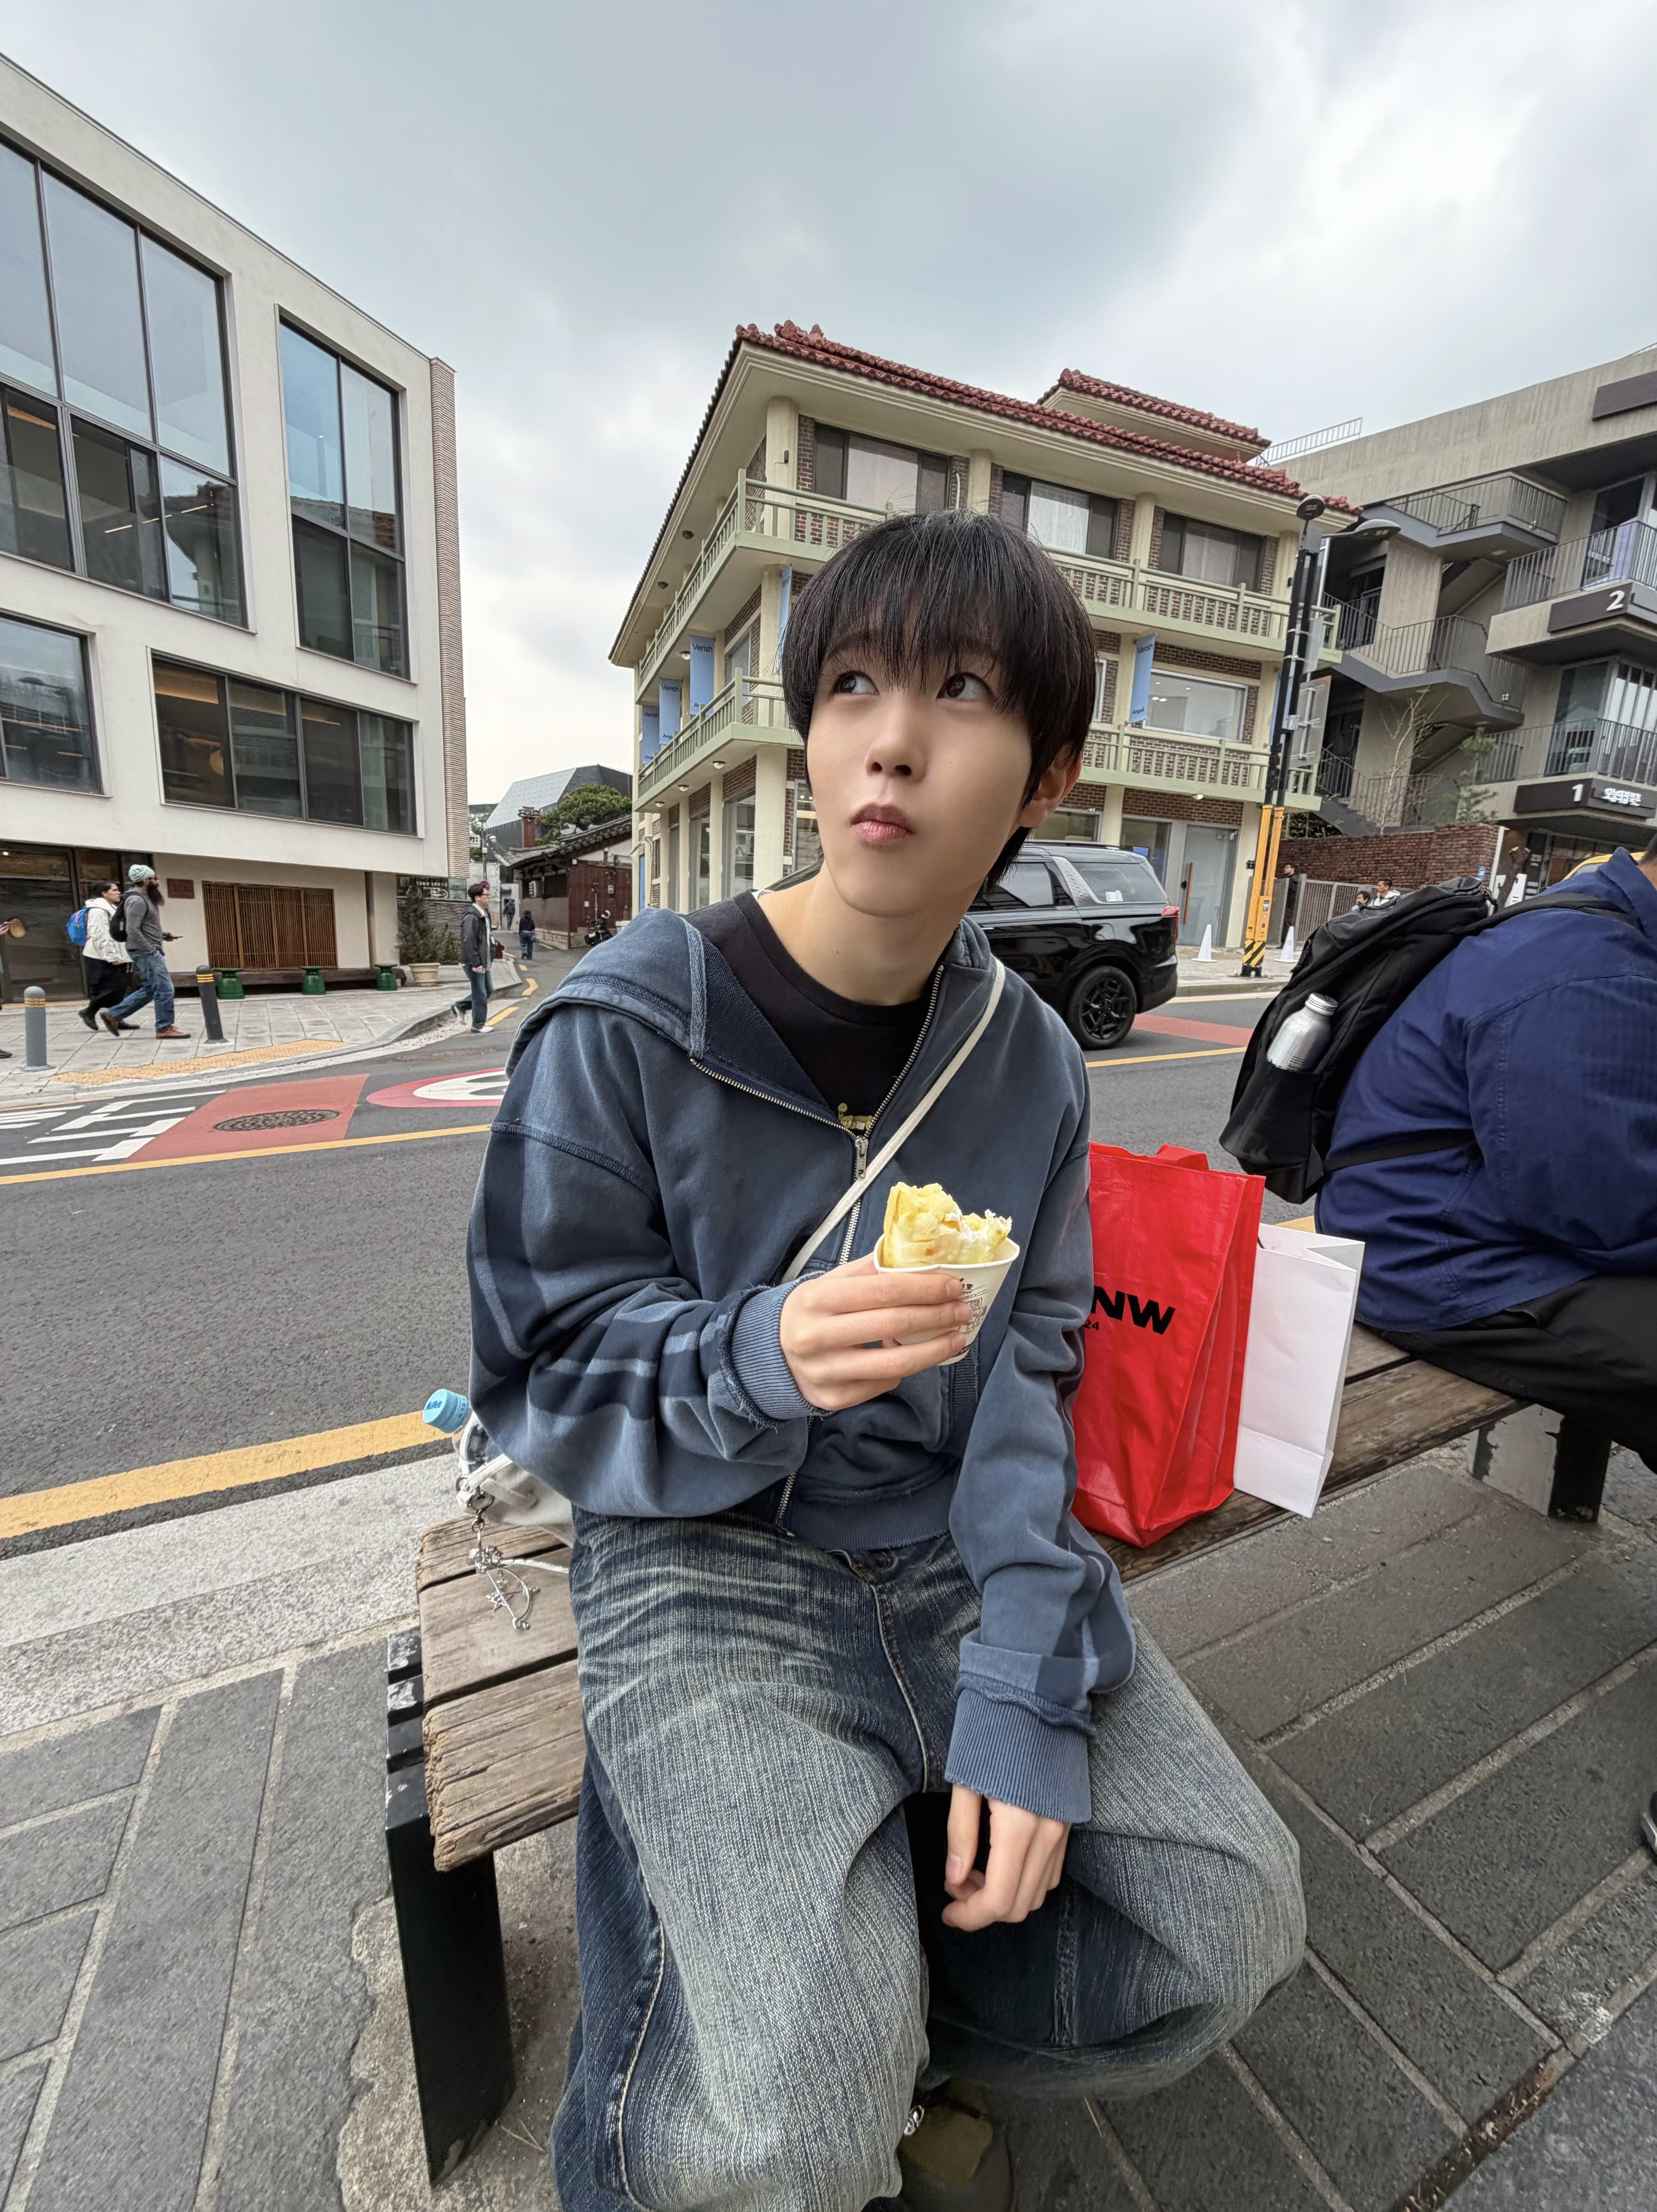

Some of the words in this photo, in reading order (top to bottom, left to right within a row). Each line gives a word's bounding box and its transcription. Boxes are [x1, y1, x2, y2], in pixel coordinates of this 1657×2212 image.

[1606, 590, 1625, 611] 2
[692, 643, 713, 652] Verish
[661, 684, 679, 692] Verish
[1572, 784, 1583, 802] 1
[1091, 1285, 1176, 1335] NW
